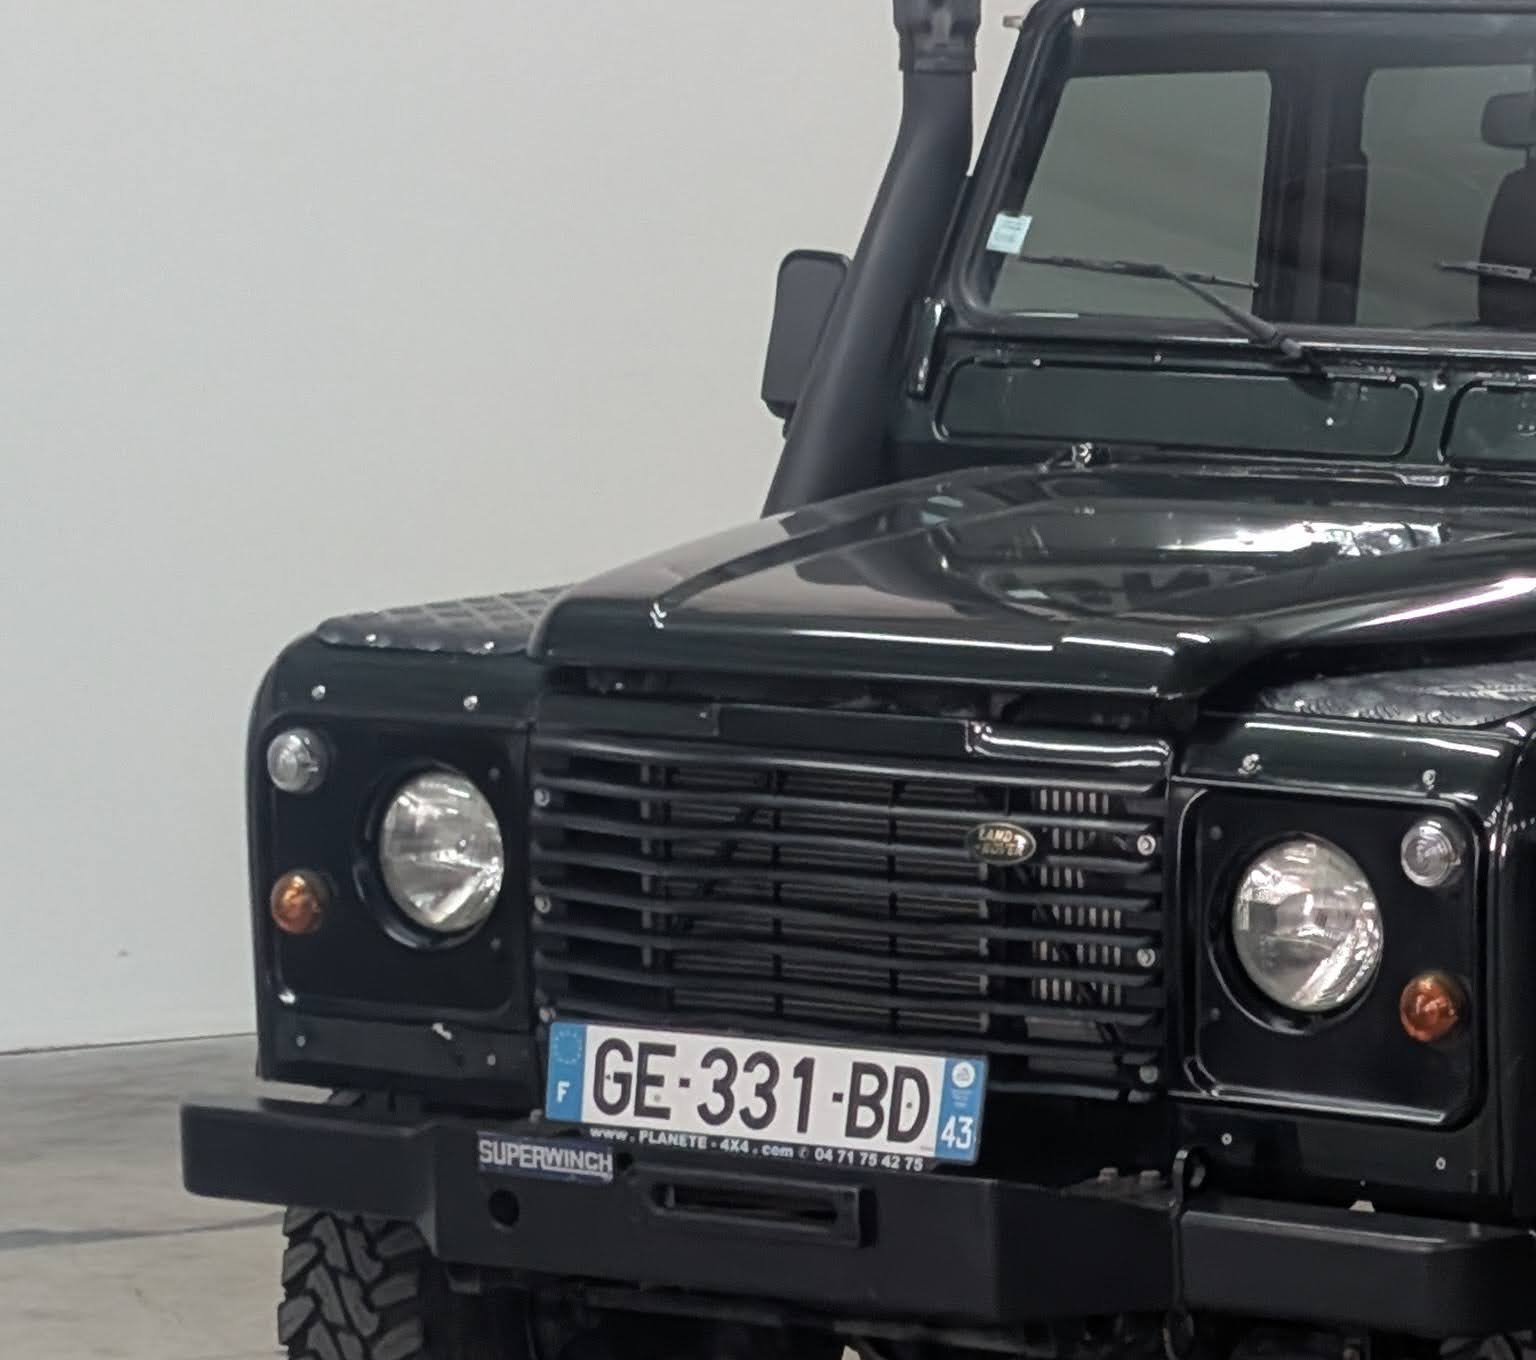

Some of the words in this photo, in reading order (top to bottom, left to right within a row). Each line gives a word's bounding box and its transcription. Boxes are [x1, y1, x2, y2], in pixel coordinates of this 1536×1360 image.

[978, 828, 1013, 843] LAND
[557, 1080, 571, 1103] F
[940, 1115, 974, 1150] 43
[479, 1139, 613, 1183] SUPERWINCH
